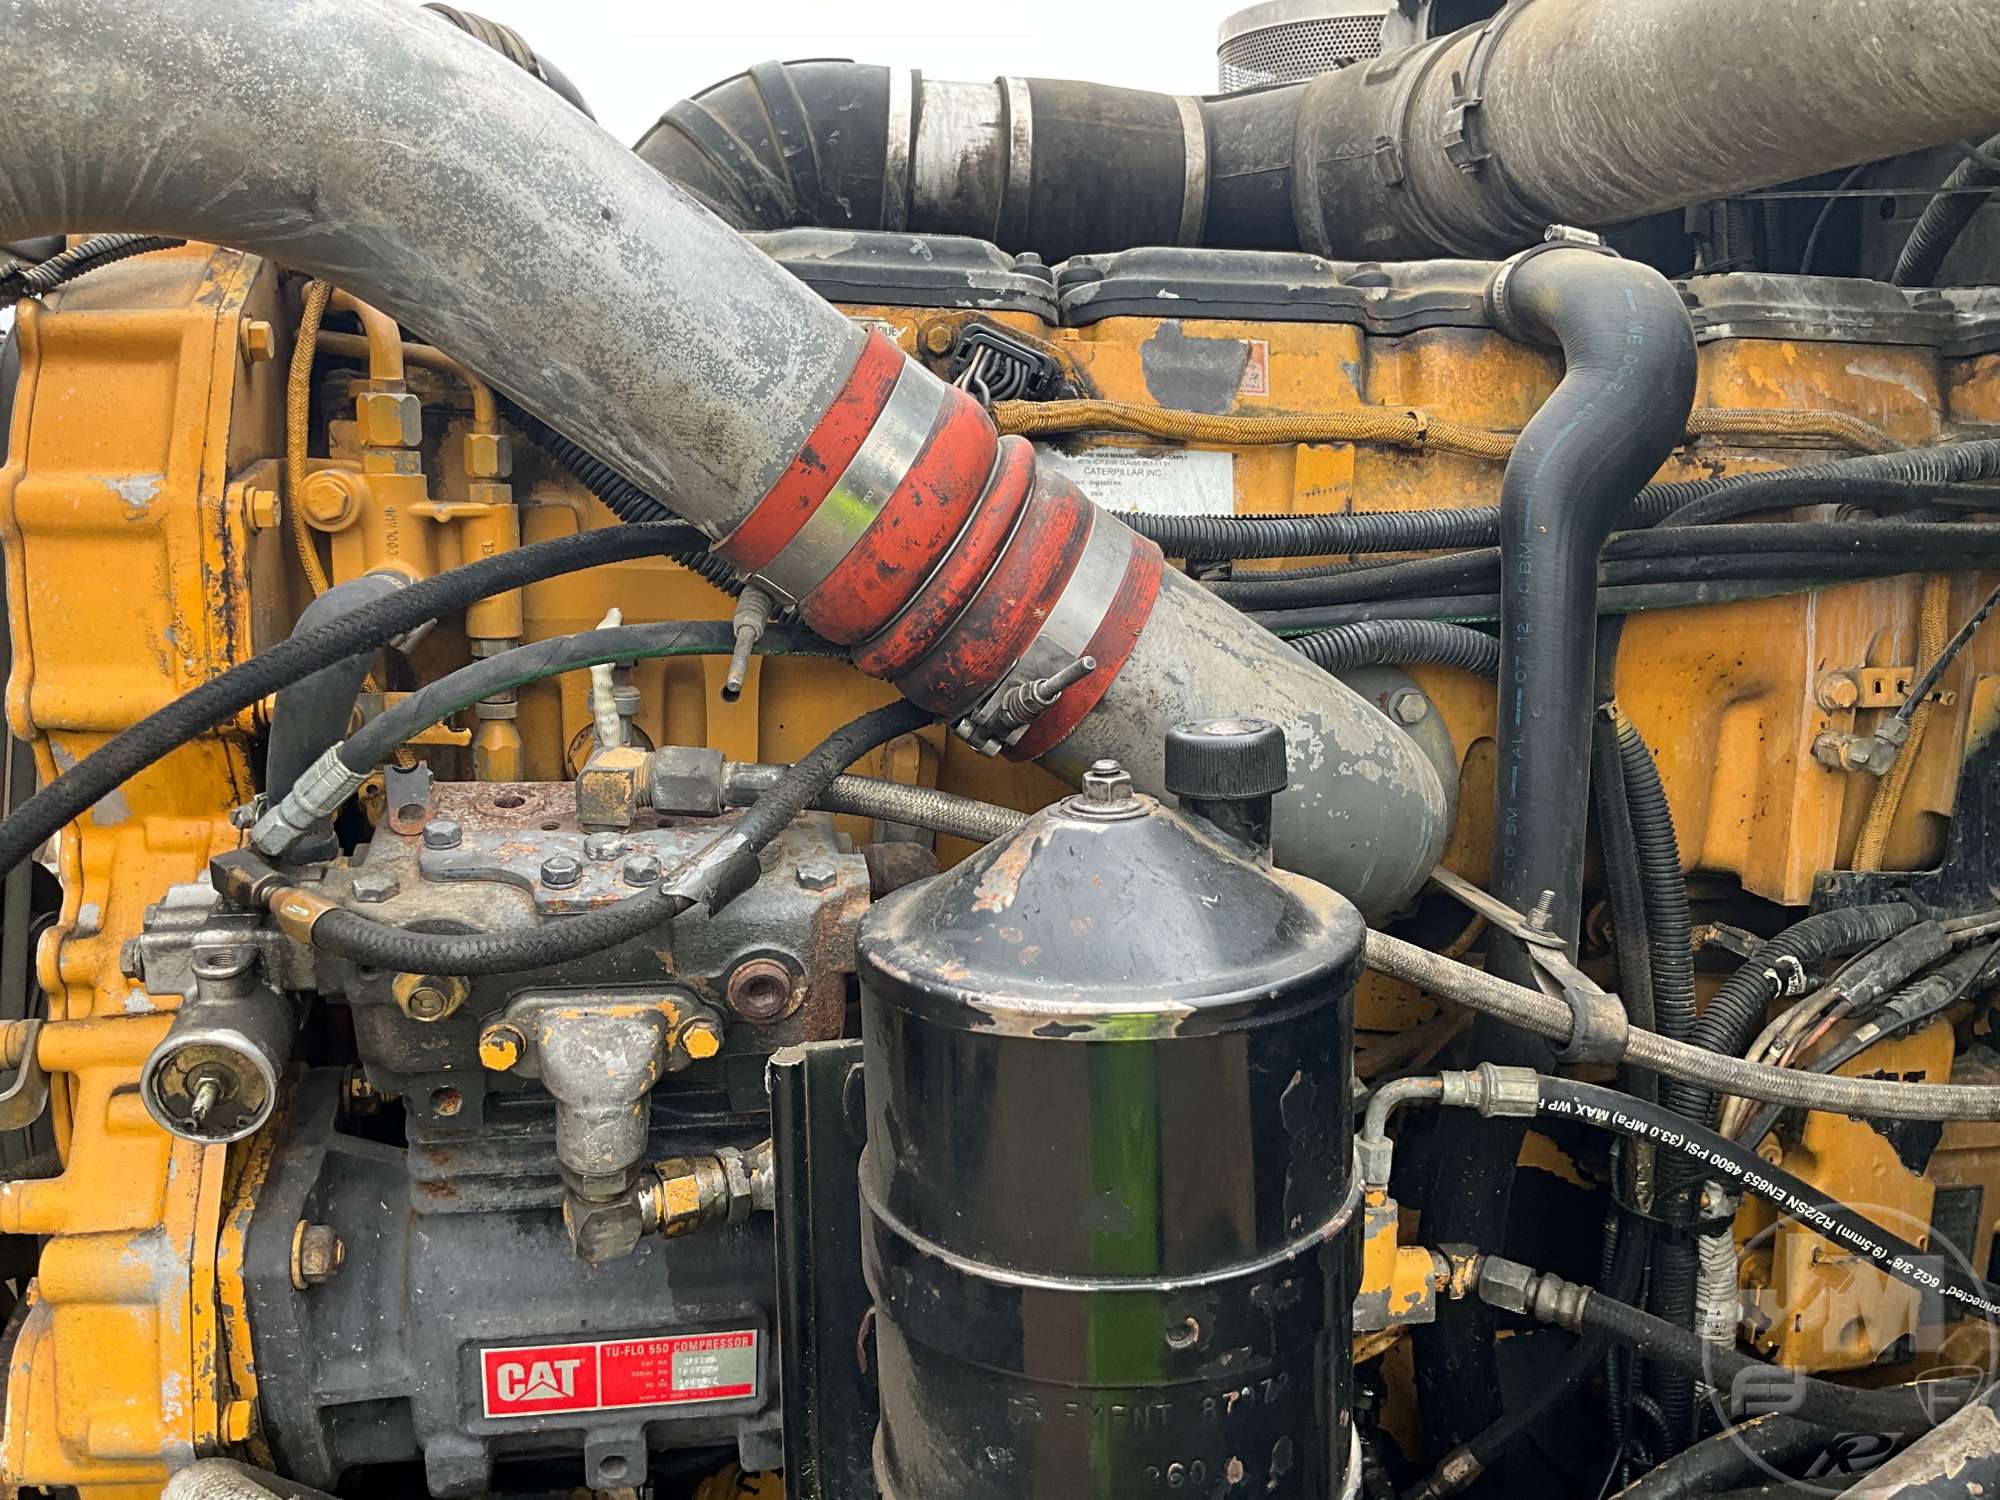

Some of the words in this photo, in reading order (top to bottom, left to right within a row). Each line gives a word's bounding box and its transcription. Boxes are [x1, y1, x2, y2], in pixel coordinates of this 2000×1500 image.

[1083, 467, 1145, 477] CATERPILLAR
[1547, 1100, 1571, 1113] WP
[1574, 1103, 1610, 1122] MAX
[1612, 1110, 1649, 1134] MPa)
[1649, 1126, 1684, 1148] (33.0
[1683, 1141, 1710, 1160] PSI
[1709, 1153, 1743, 1176] 4800
[1742, 1171, 1788, 1201] EN853
[1785, 1195, 1836, 1230] R2/2SN
[1835, 1224, 1888, 1260] (9.5mm)
[1912, 1268, 1940, 1288] 6G2
[605, 1344, 645, 1358] TU-FLO
[649, 1343, 669, 1354] 550
[673, 1337, 749, 1352] COMPRESSOR
[497, 1358, 581, 1402] CAT
